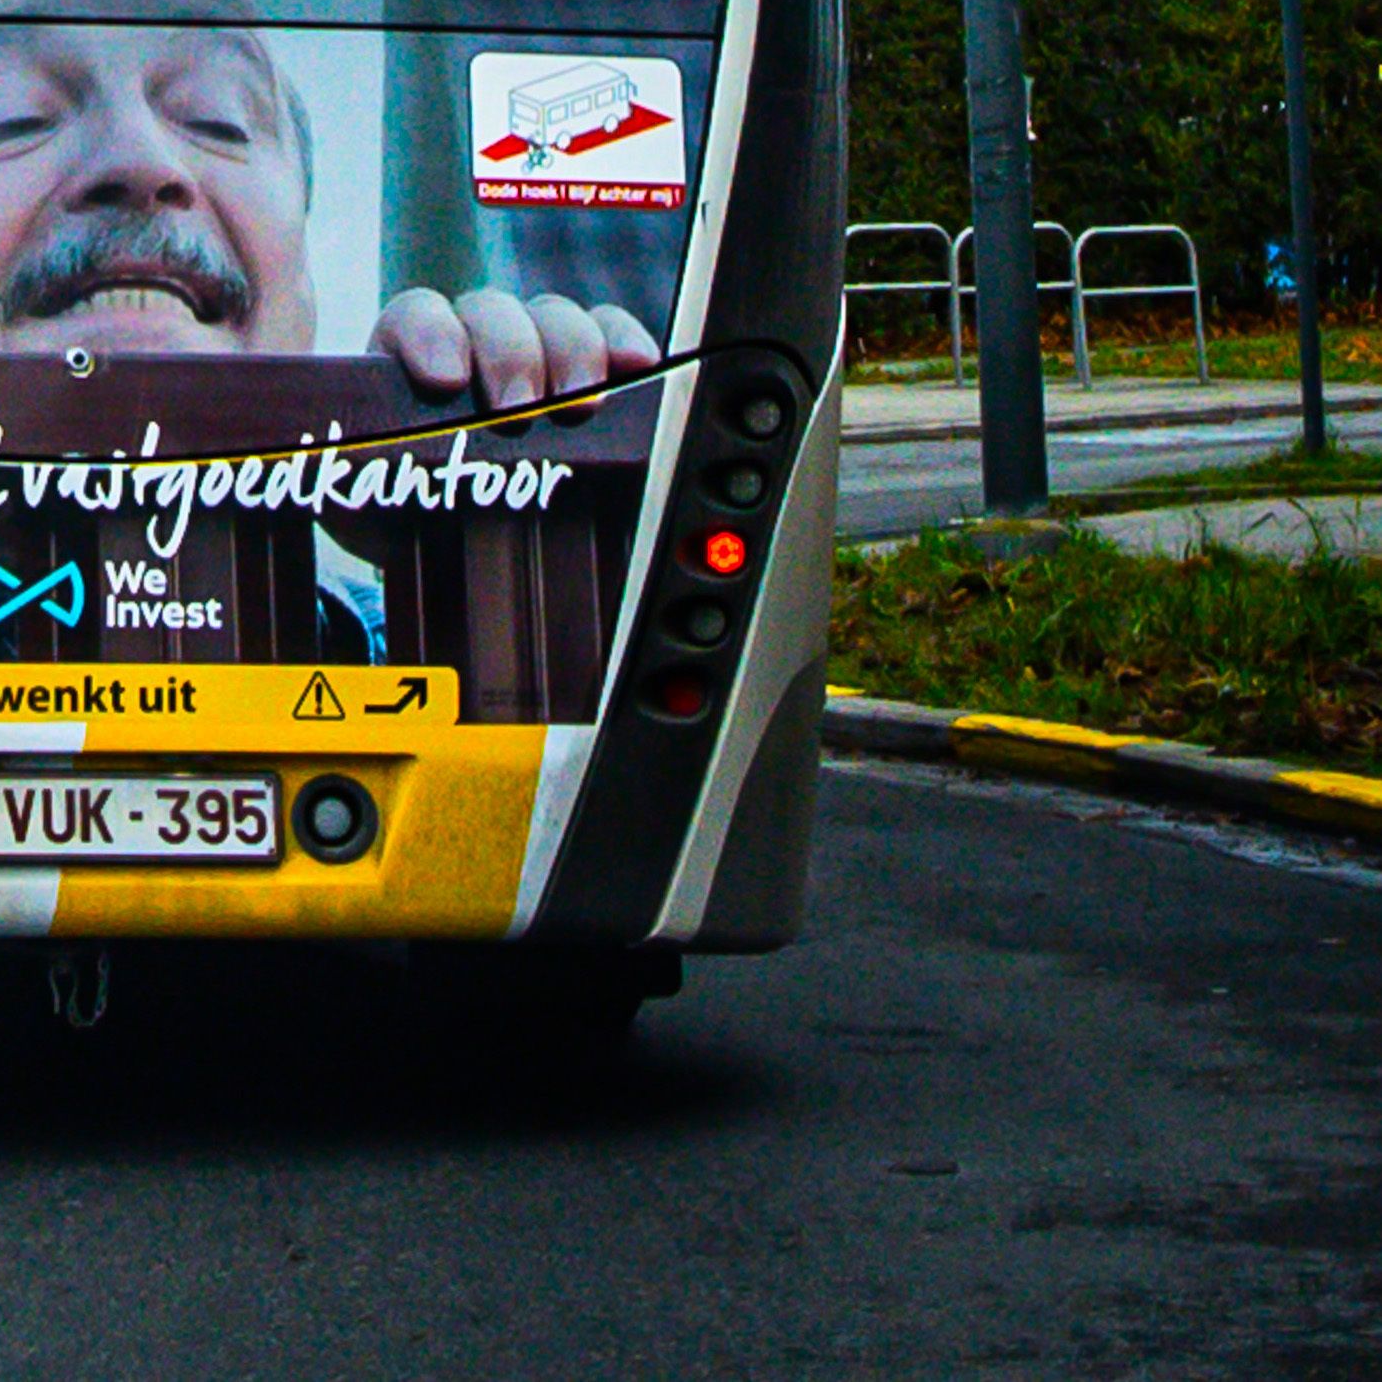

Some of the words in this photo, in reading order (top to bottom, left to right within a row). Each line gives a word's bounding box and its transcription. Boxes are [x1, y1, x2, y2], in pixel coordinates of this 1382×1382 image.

[22, 420, 572, 558] vastgoedkantoor
[104, 560, 168, 596] We
[105, 594, 224, 629] Invest
[139, 676, 197, 713] uit
